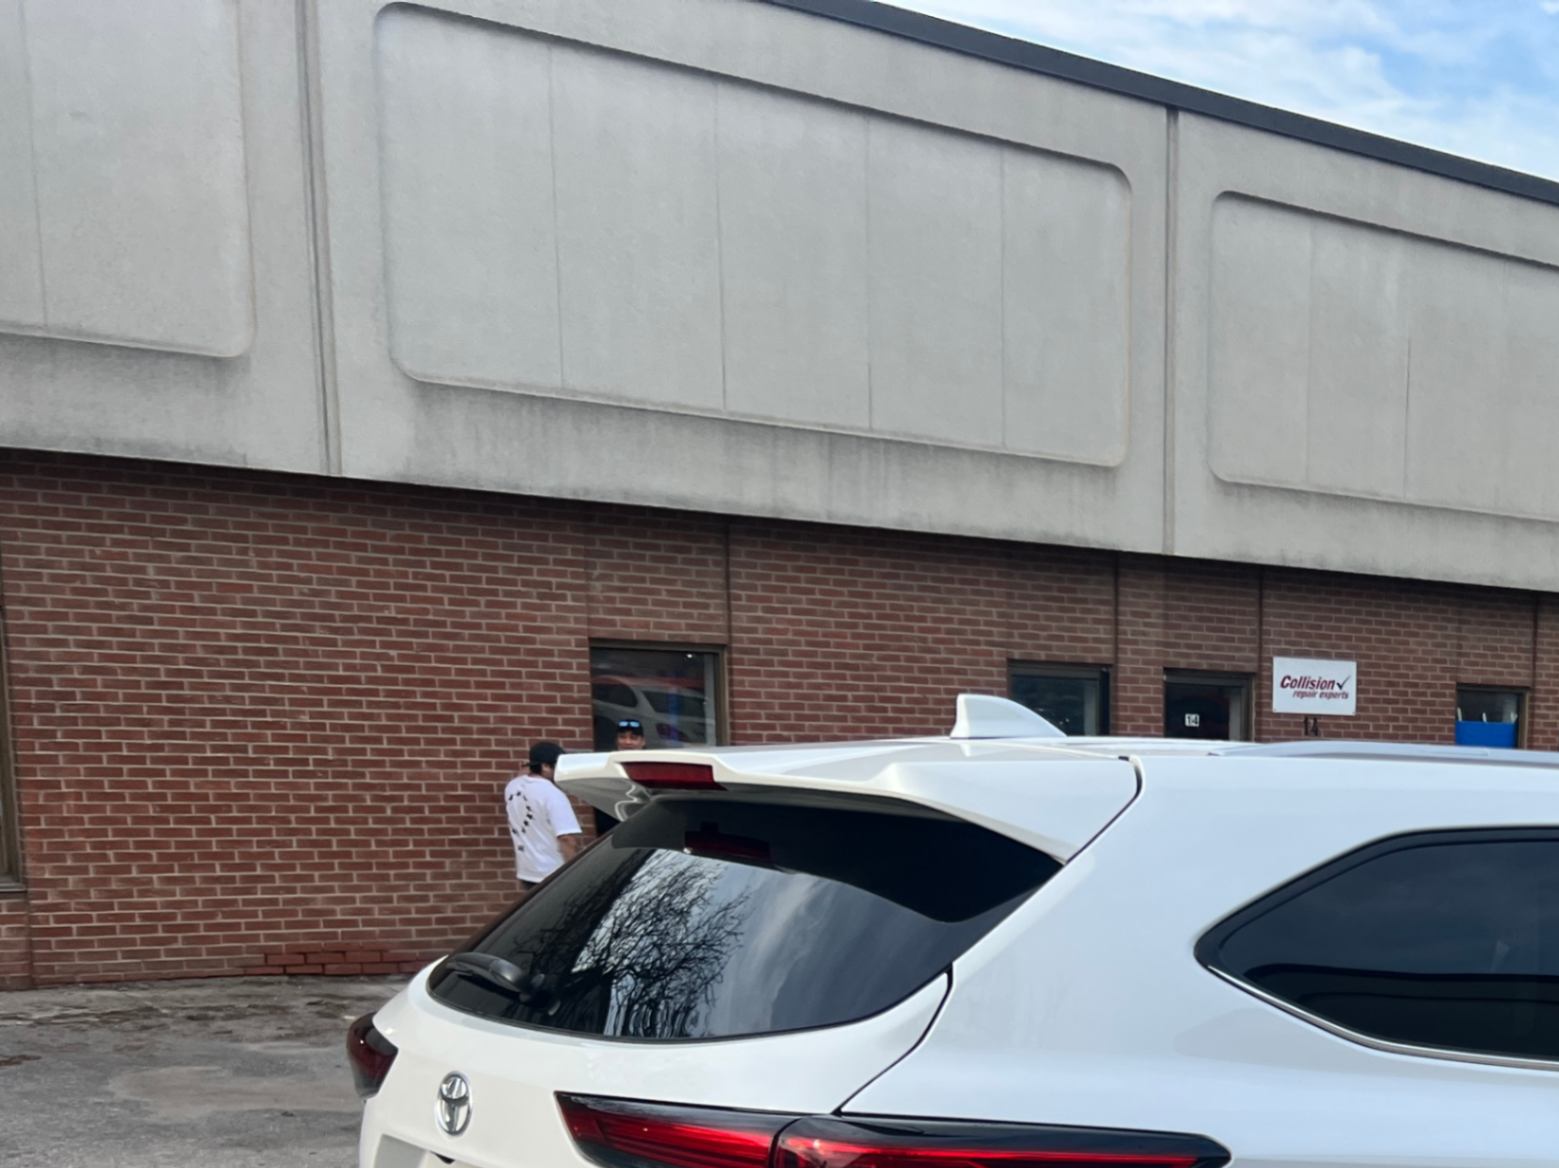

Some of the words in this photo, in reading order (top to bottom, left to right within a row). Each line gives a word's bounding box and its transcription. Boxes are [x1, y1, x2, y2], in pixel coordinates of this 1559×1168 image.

[1280, 675, 1335, 690] Collision
[1293, 690, 1317, 699] repair
[1319, 691, 1349, 700] experts
[1187, 714, 1199, 725] 14
